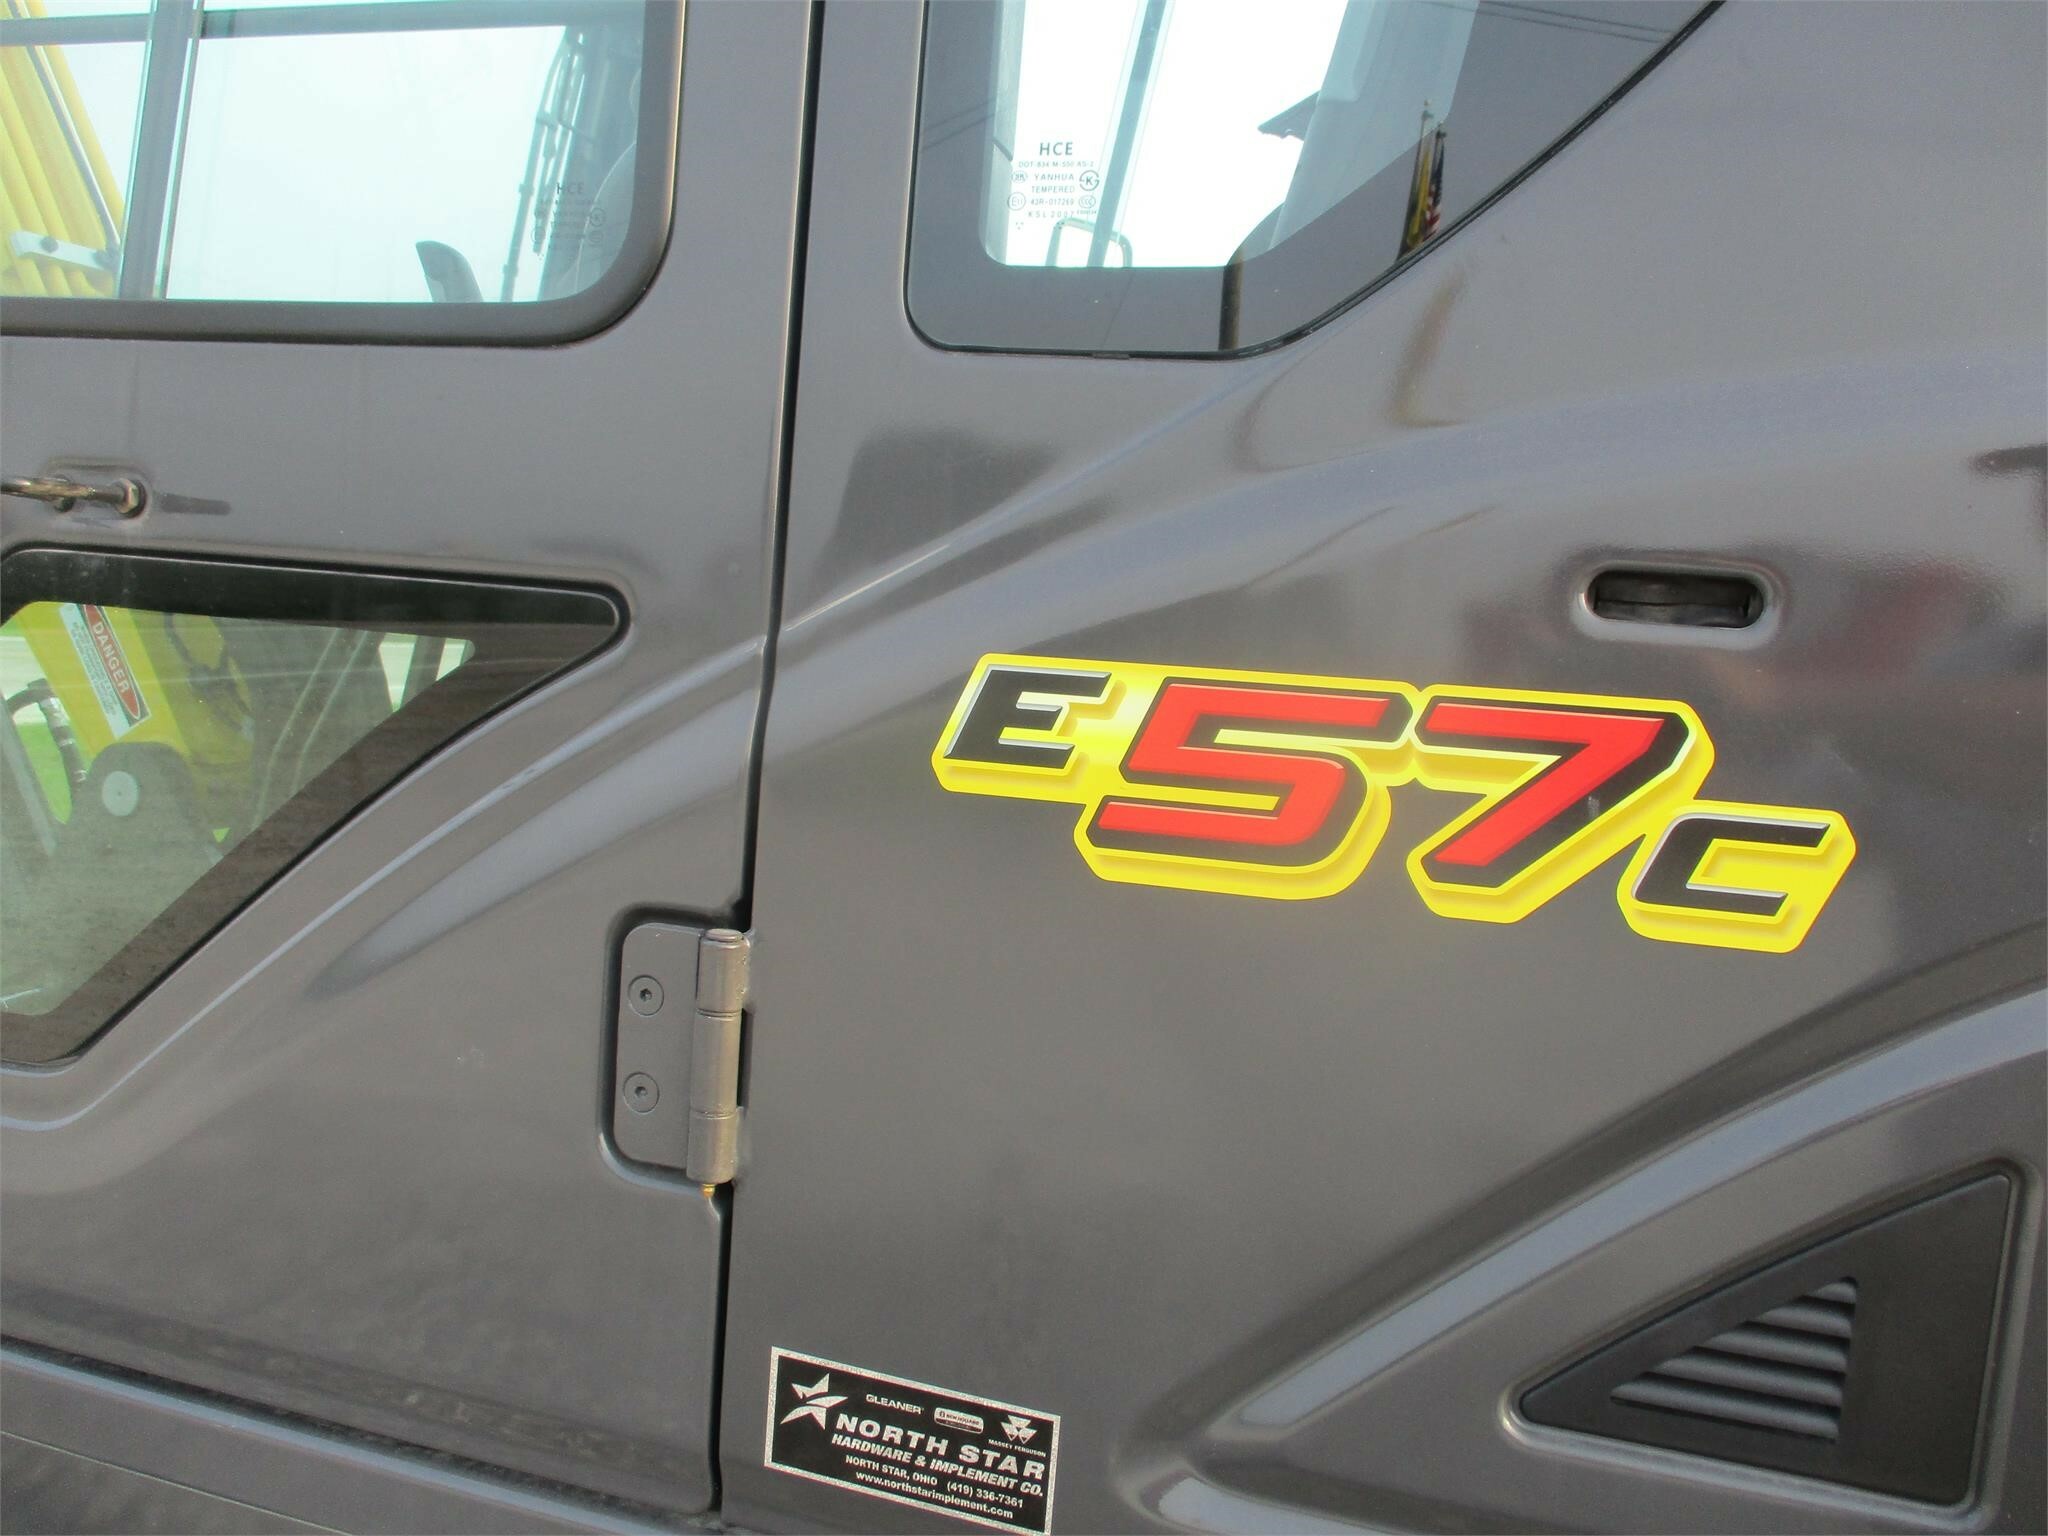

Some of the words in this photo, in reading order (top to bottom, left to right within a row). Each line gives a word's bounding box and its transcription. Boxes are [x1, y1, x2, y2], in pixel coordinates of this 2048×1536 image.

[1039, 142, 1074, 156] HCE
[1031, 185, 1076, 193] TEMPERED
[1034, 173, 1075, 181] YANHUA
[92, 624, 130, 693] DANGER
[865, 1393, 922, 1415] GLEANER
[836, 1413, 949, 1456] NORTH
[958, 1445, 1046, 1480] STAR
[1014, 1445, 1047, 1457] FERGUSON
[831, 1433, 912, 1464] HARDWARE
[914, 1454, 927, 1467] &
[930, 1458, 1019, 1490] IMPLEMENT
[1020, 1481, 1044, 1497] CO.
[845, 1454, 880, 1471] NORTH
[881, 1463, 910, 1481] STAR,
[912, 1472, 938, 1486] OHIO
[947, 1481, 974, 1498] (419)
[976, 1487, 1024, 1509] 336-7361
[856, 1471, 1013, 1519] www.northstarimplement.com
